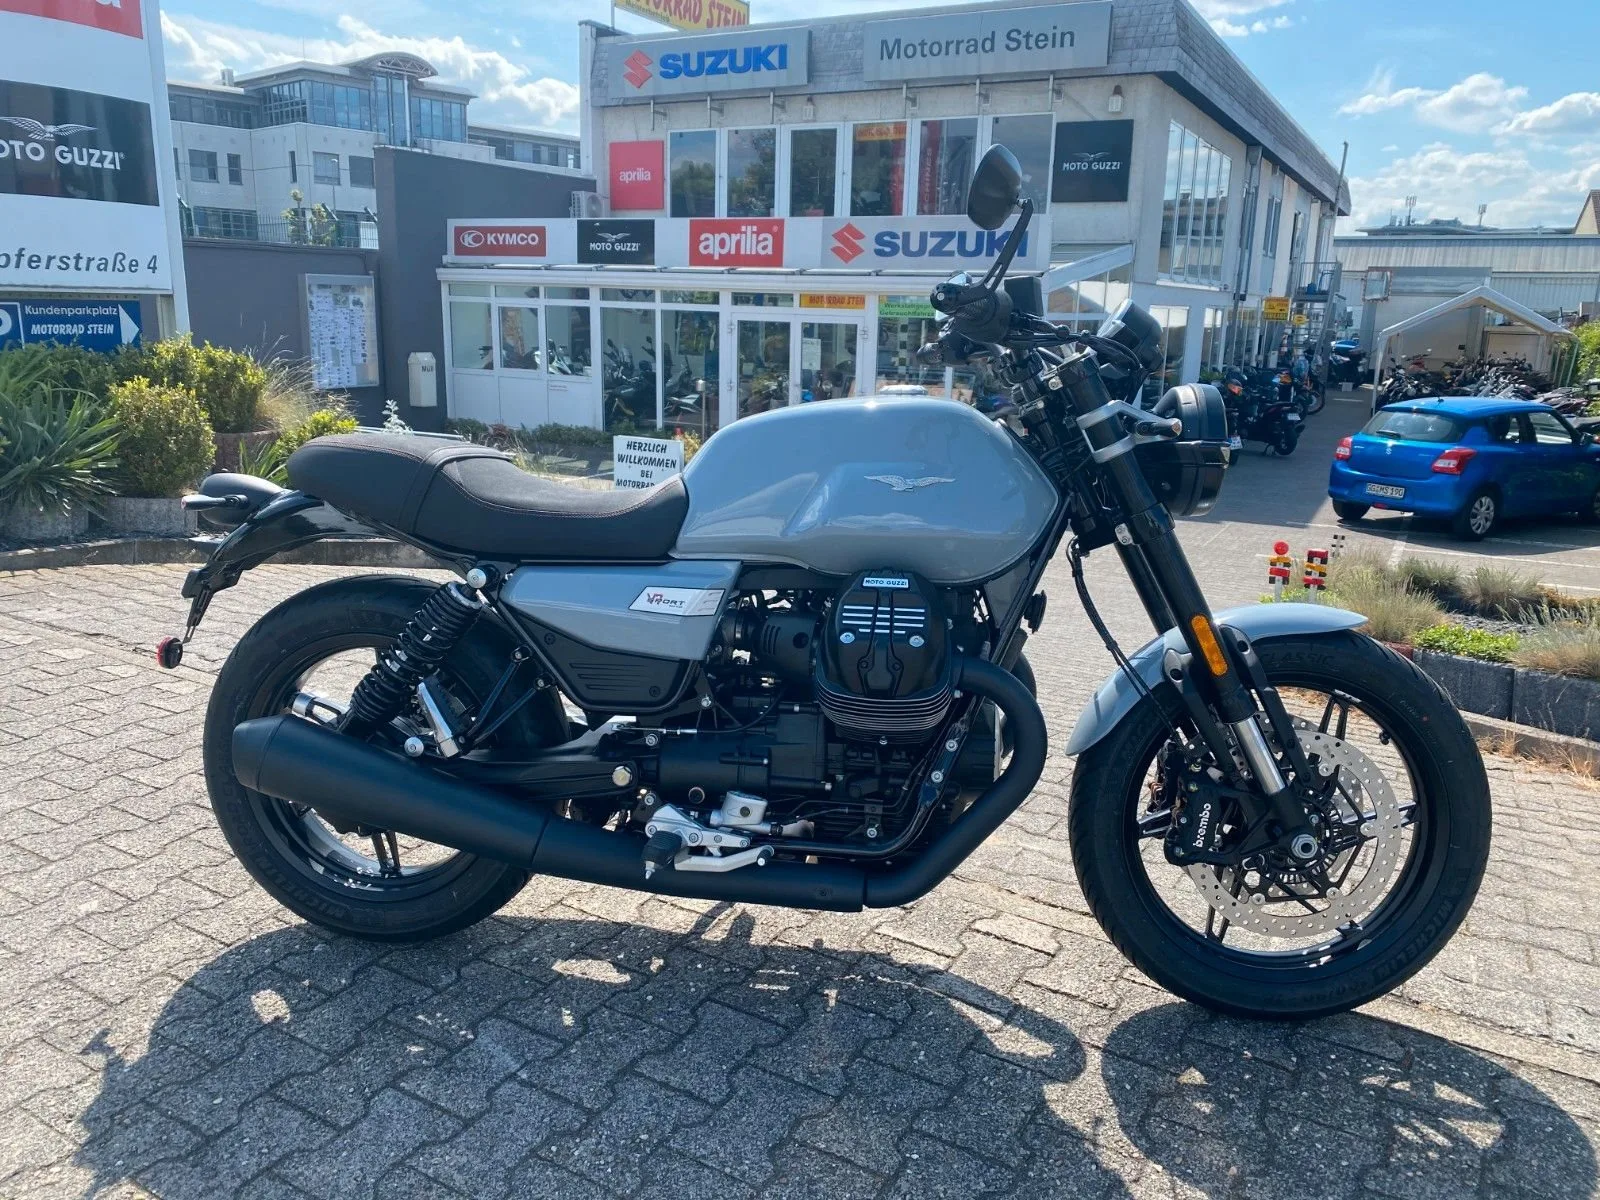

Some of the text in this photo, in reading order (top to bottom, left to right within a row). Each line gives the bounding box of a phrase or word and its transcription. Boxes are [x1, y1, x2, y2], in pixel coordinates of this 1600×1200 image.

[879, 25, 1075, 61] Motorrad Stein
[659, 43, 788, 80] SUZUKI
[1062, 161, 1121, 171] MOTO GUZZI
[619, 167, 651, 184] aprilia
[486, 232, 539, 246] KYMCO
[589, 242, 639, 252] MOTO GUZZI
[698, 225, 773, 260] aprilia
[873, 230, 1029, 258] SUZUKI
[147, 254, 158, 274] 4
[25, 305, 118, 317] Kundenparkplatz
[31, 324, 114, 335] MOTORRAD STEIN
[626, 441, 667, 454] HERZLICH
[617, 453, 677, 469] WILLKOMMEN
[640, 470, 653, 479] BEI
[1193, 803, 1212, 848] brembo
